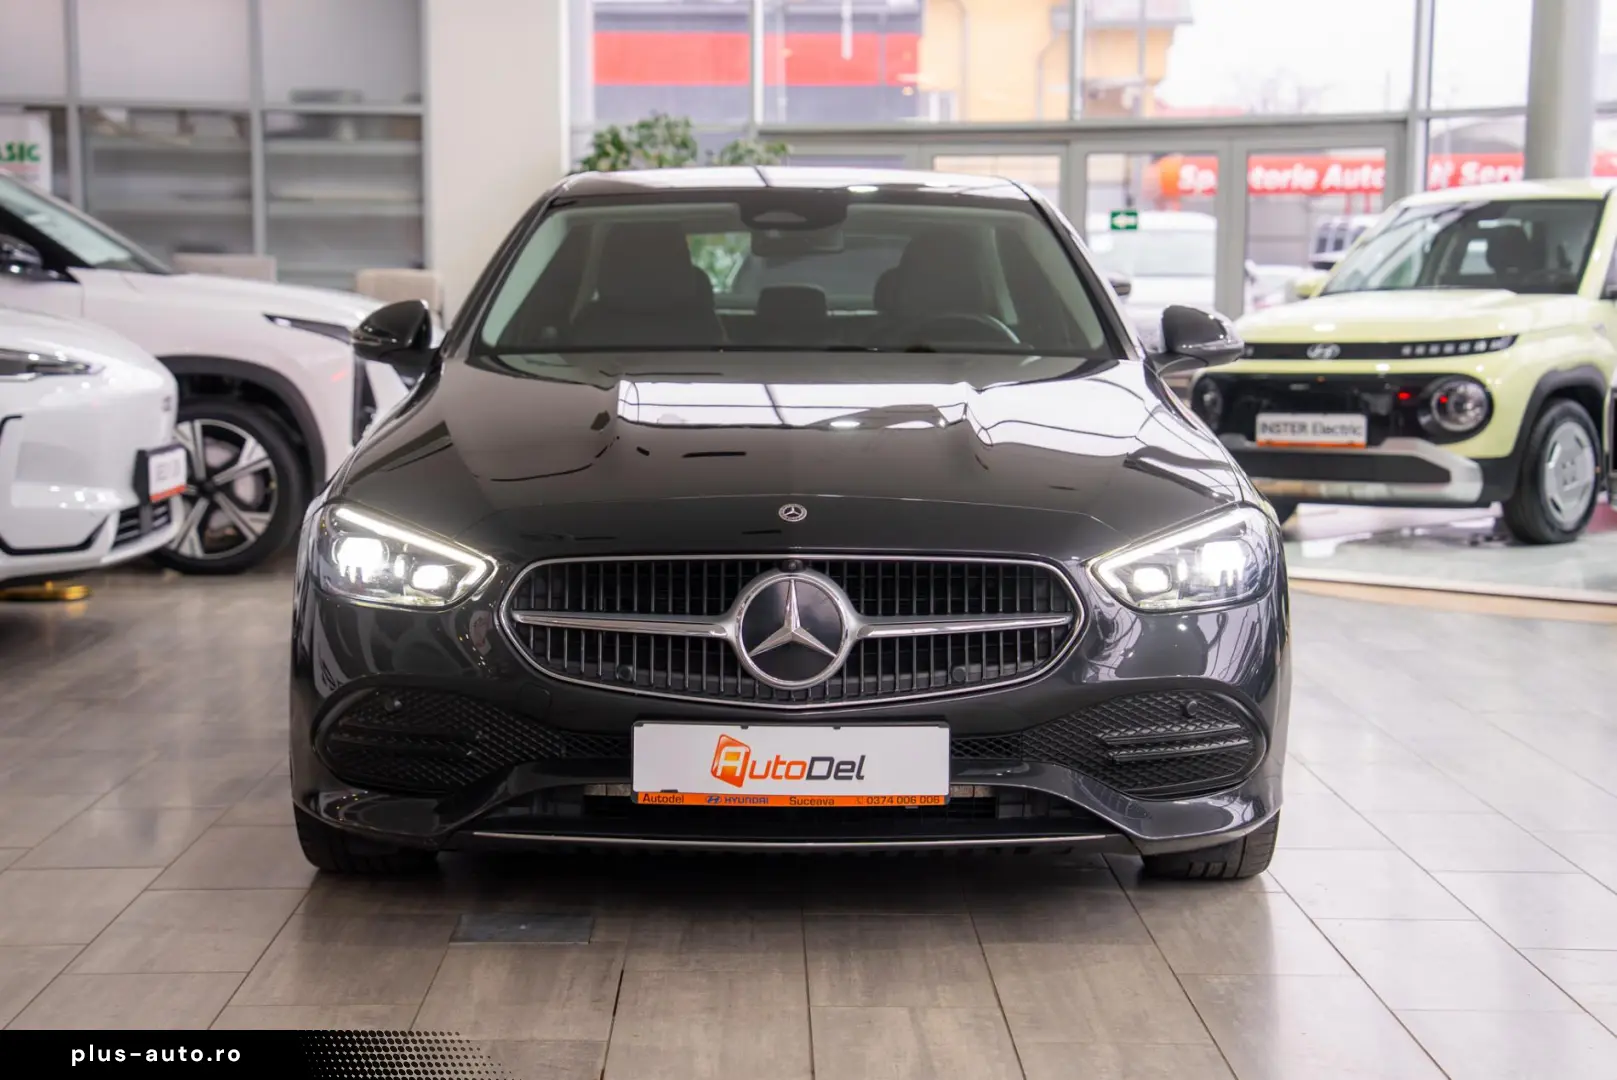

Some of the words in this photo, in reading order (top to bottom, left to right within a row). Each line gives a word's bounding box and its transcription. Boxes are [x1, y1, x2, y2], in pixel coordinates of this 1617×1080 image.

[714, 743, 866, 781] AutoDel
[642, 793, 685, 804] Autodel
[789, 796, 835, 806] Suceava
